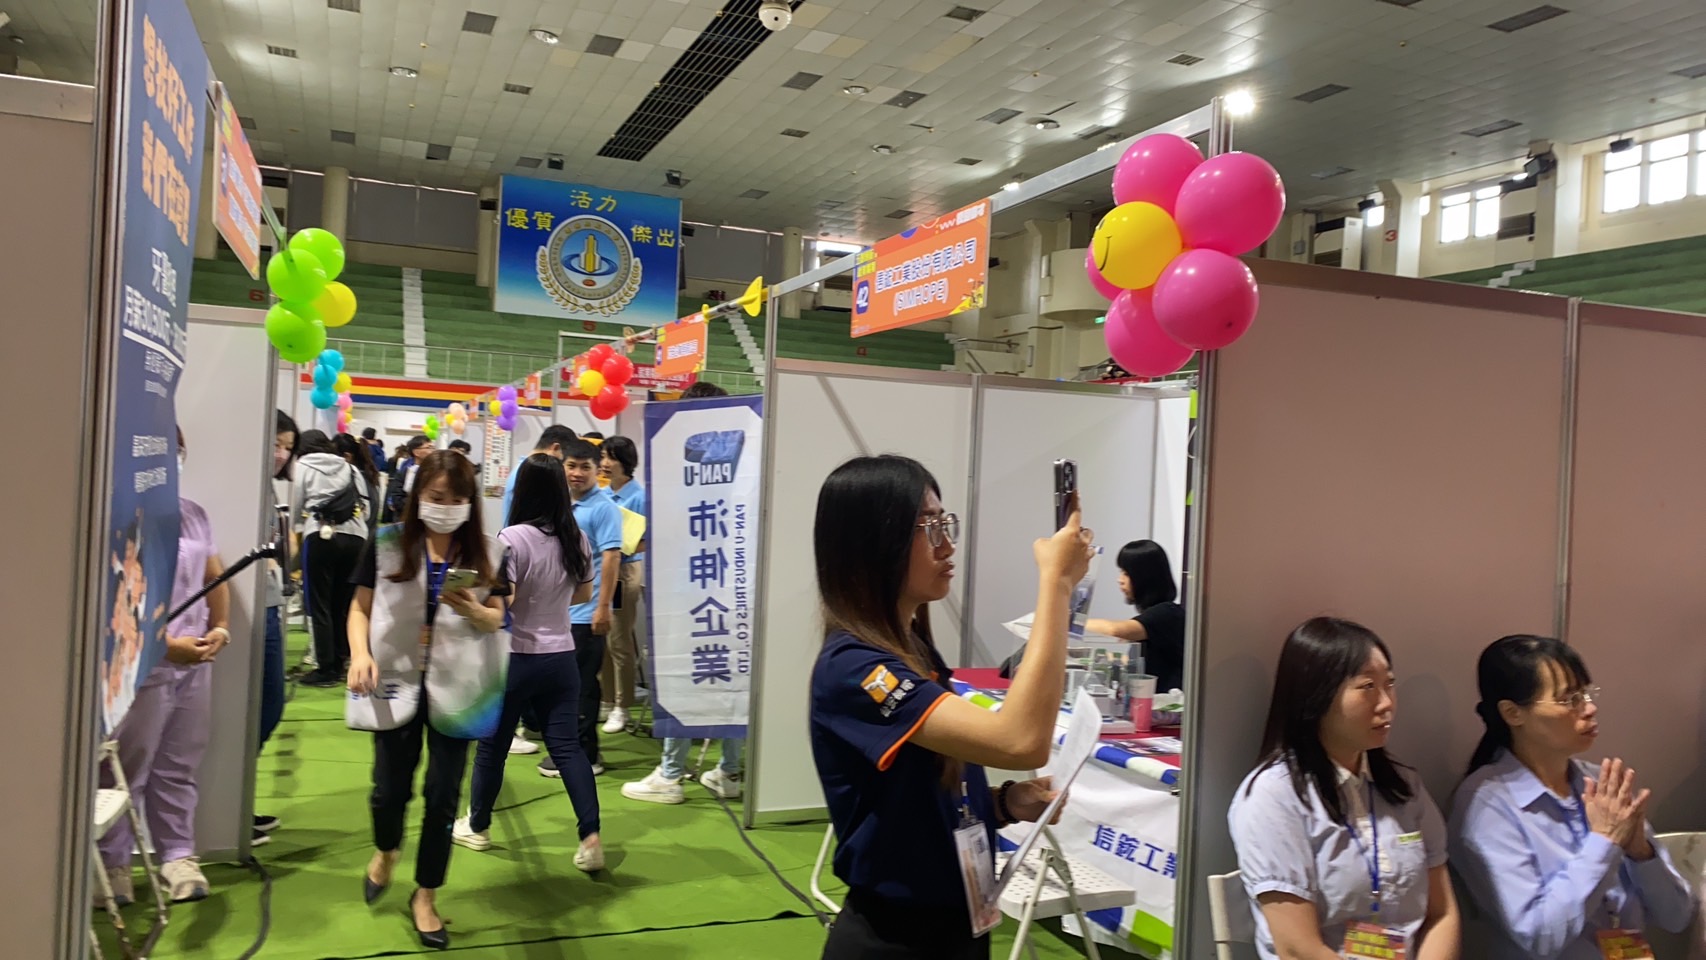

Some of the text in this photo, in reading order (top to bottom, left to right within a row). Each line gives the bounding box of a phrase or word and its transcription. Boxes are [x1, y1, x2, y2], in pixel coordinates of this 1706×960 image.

[570, 189, 618, 213] 活力
[504, 207, 555, 231] 優質
[630, 224, 676, 248] 傑出
[1385, 229, 1398, 242] 3
[249, 288, 265, 302] 6
[856, 286, 868, 308] 42
[583, 320, 596, 331] 5
